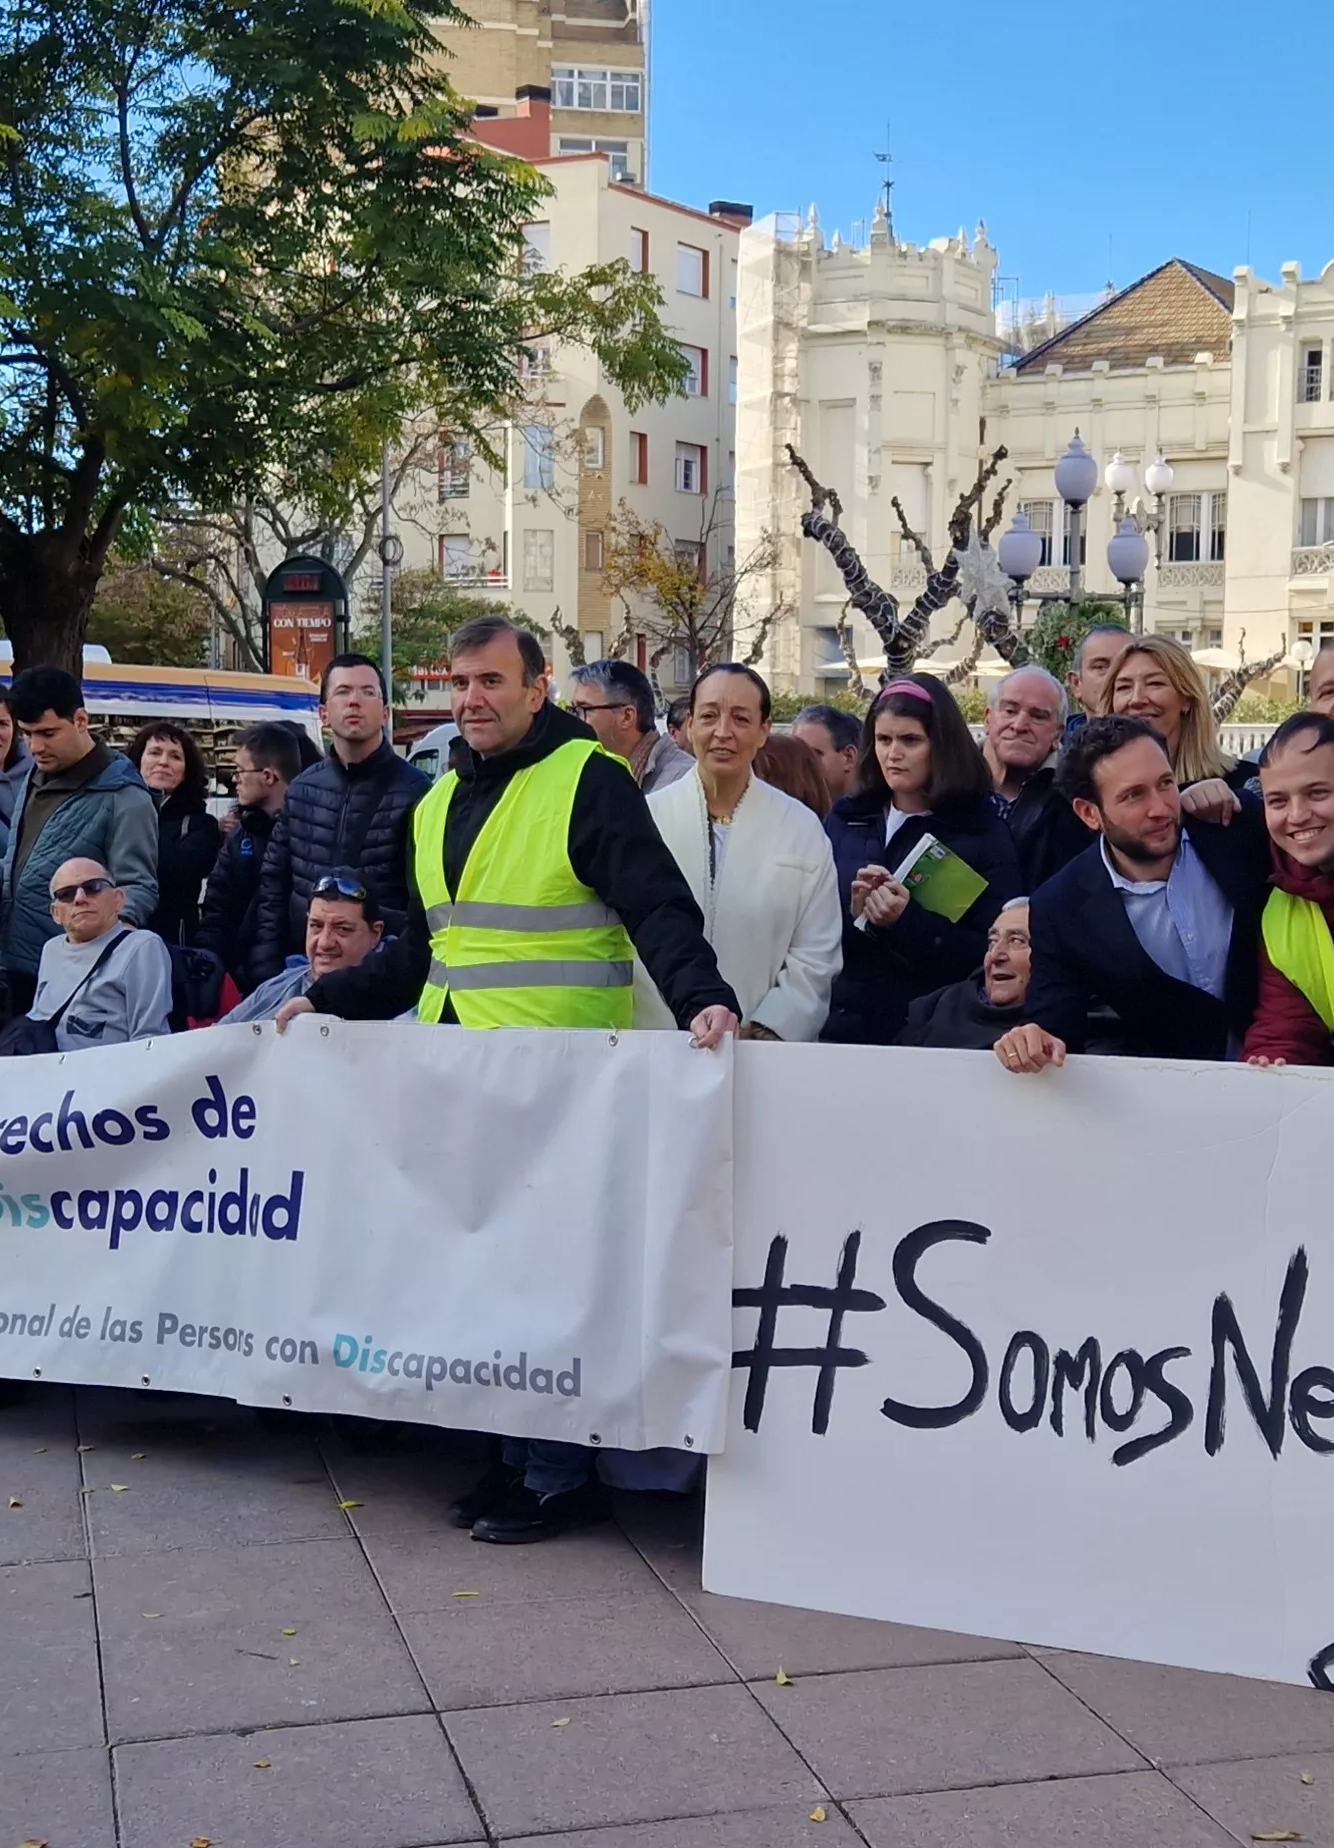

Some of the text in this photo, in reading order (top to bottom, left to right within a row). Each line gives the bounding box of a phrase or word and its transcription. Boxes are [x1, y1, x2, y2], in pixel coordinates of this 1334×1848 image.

[273, 617, 332, 629] CON TIEMPO
[191, 1075, 257, 1140] de
[58, 1303, 91, 1340] de
[99, 1306, 143, 1344] las
[265, 1333, 319, 1366] con
[332, 1332, 582, 1398] Discapacidad
